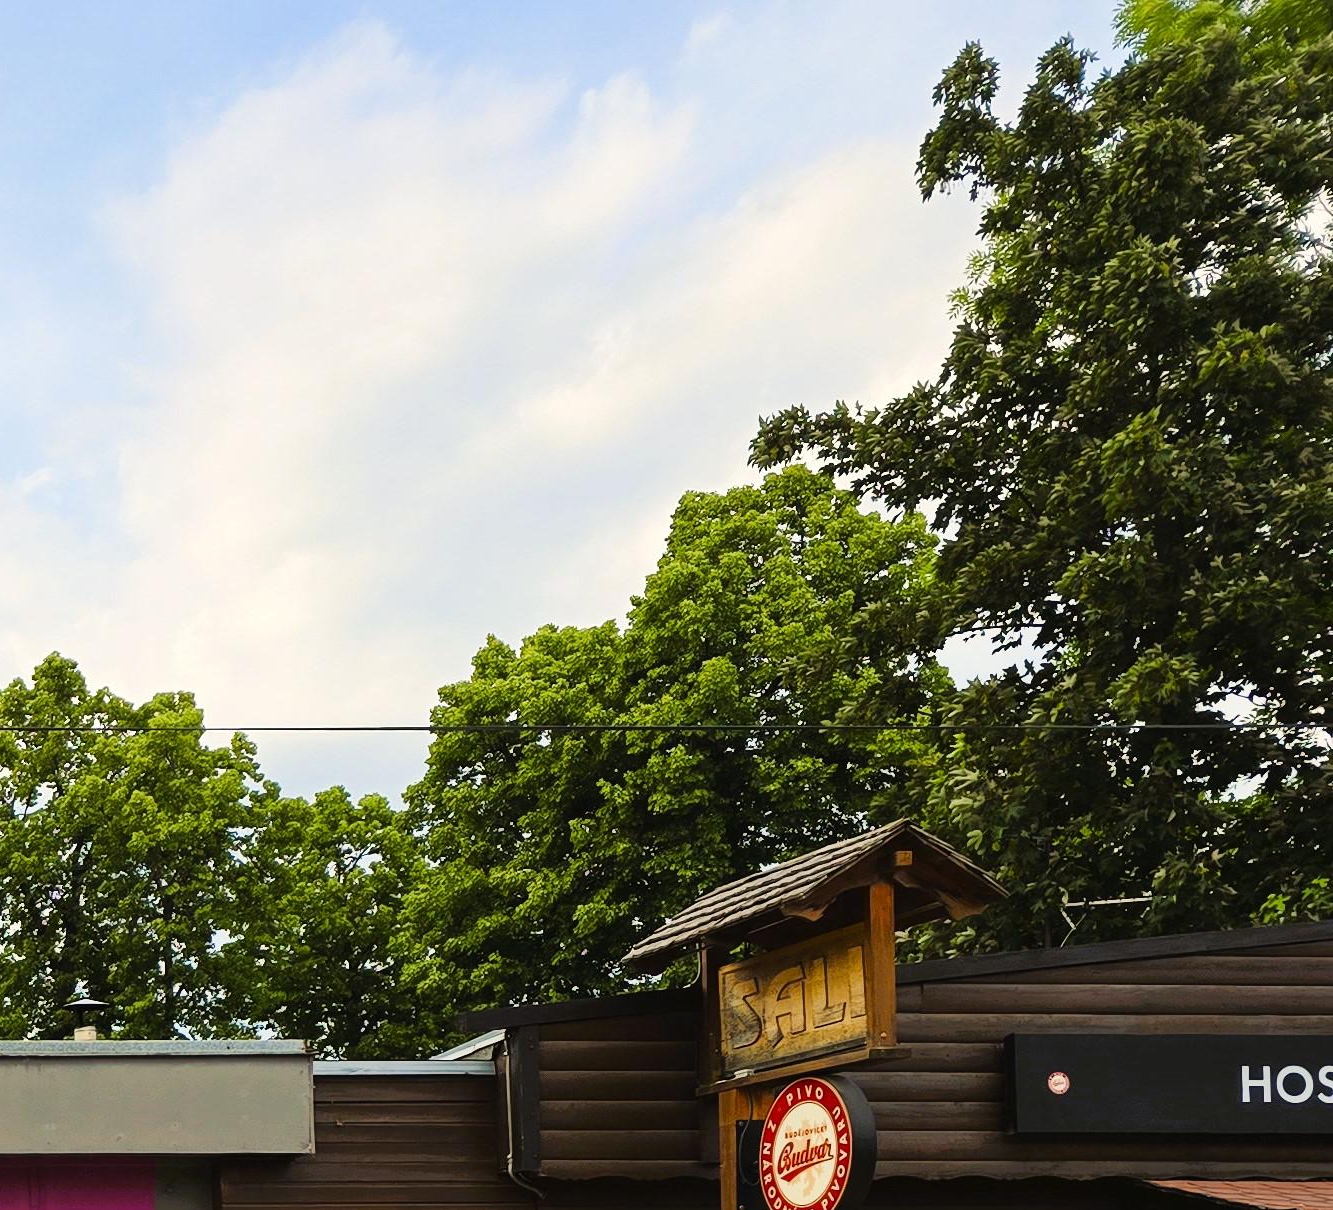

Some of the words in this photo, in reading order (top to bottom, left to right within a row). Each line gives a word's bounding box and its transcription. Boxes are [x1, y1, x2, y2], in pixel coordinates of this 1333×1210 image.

[726, 946, 866, 1049] SALI
[786, 1084, 824, 1107] PIVO
[767, 1119, 777, 1133] Z
[777, 1138, 834, 1176] Budvar
